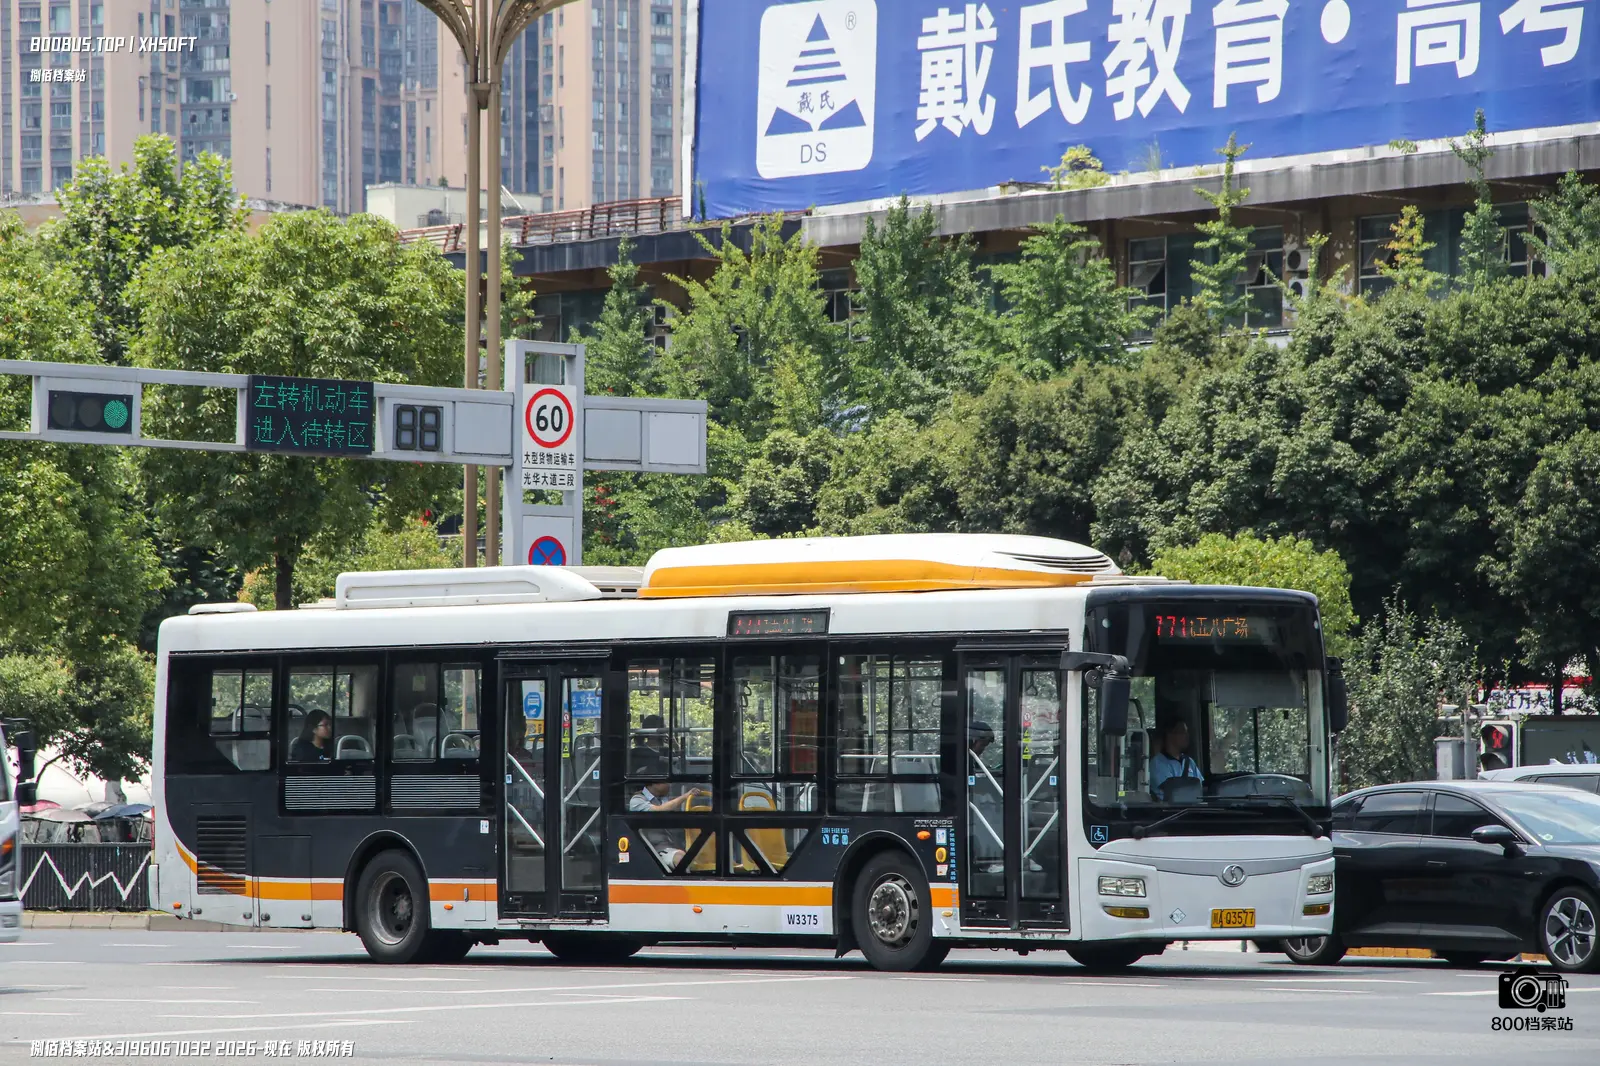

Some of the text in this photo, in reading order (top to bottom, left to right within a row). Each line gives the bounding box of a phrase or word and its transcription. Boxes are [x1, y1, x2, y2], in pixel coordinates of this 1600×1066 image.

[797, 90, 835, 114] 戴氏
[800, 142, 827, 164] DS
[254, 379, 370, 414] 左转机动车
[535, 404, 564, 432] 60
[254, 417, 370, 449] 进入待转区
[523, 451, 575, 466] 大型货物运输车
[523, 472, 575, 486] 光华大道三段
[787, 913, 818, 926] W3375
